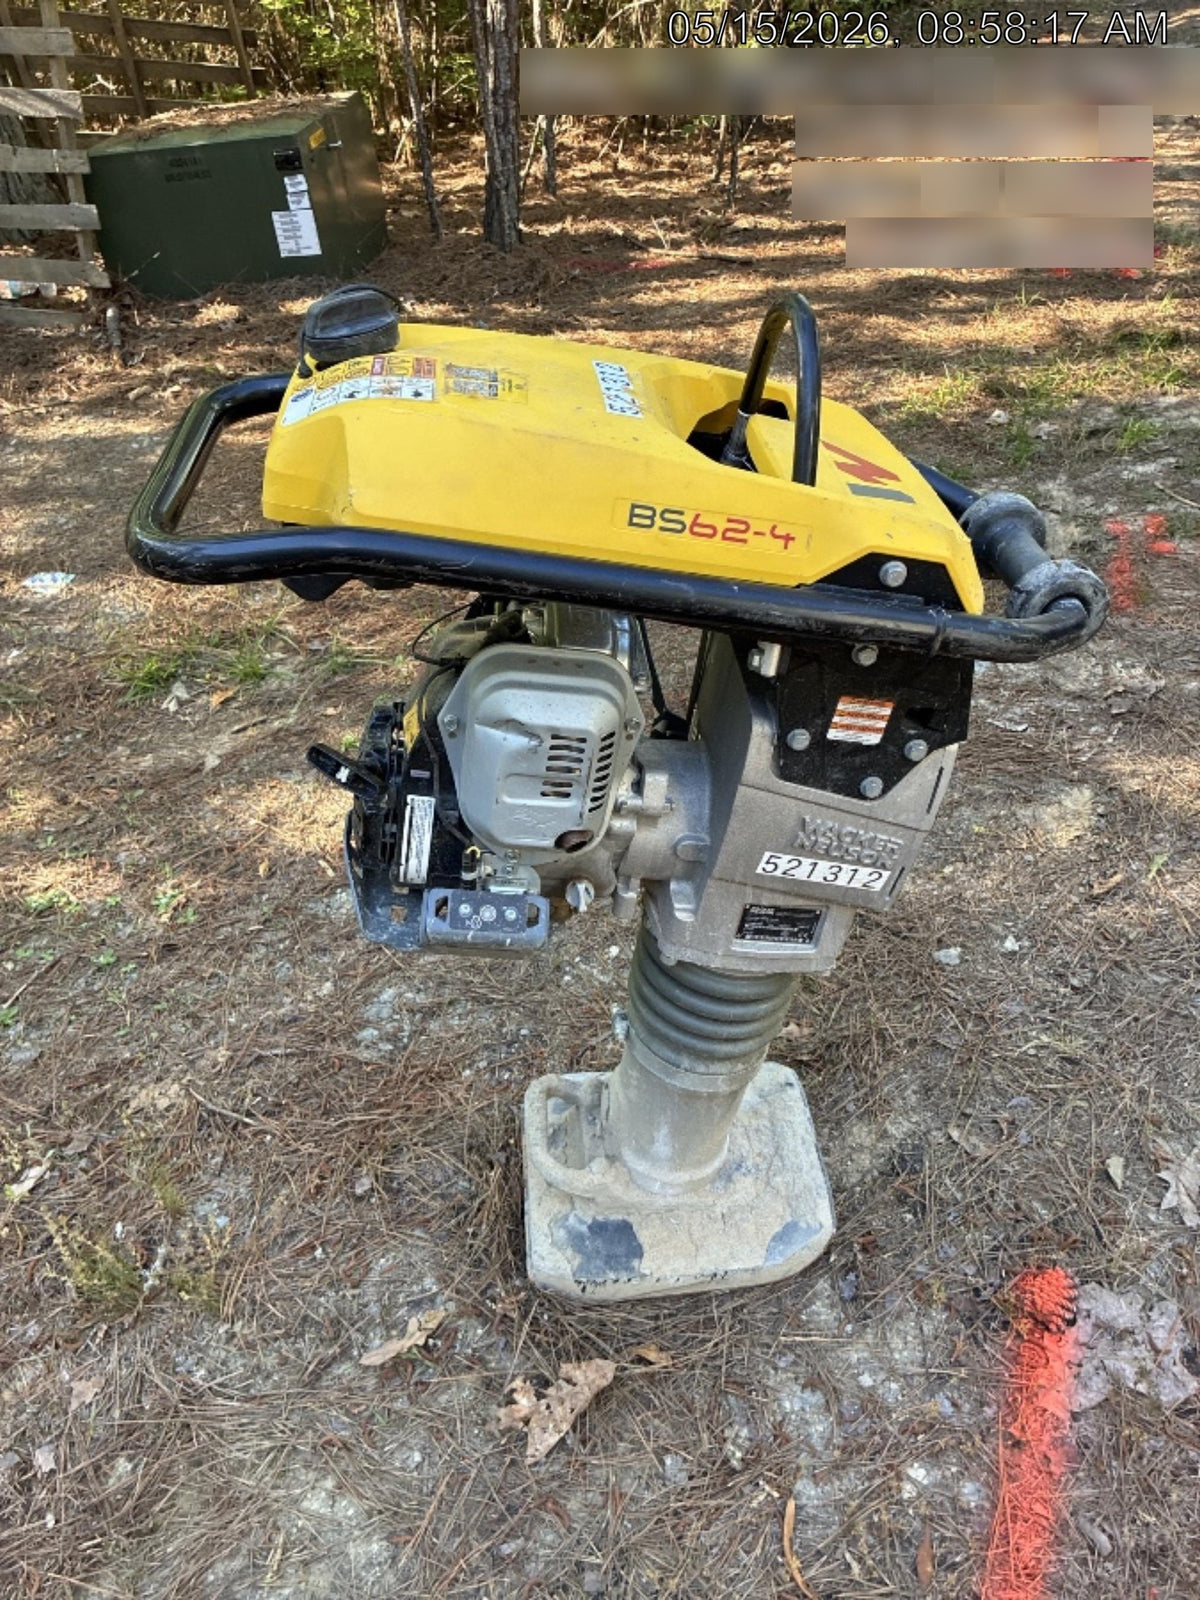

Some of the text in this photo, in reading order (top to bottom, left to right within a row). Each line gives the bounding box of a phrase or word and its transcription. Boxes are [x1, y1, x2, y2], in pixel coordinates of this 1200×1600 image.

[627, 502, 796, 550] BS62-4
[802, 815, 904, 860] WACKER
[761, 854, 883, 890] 521312
